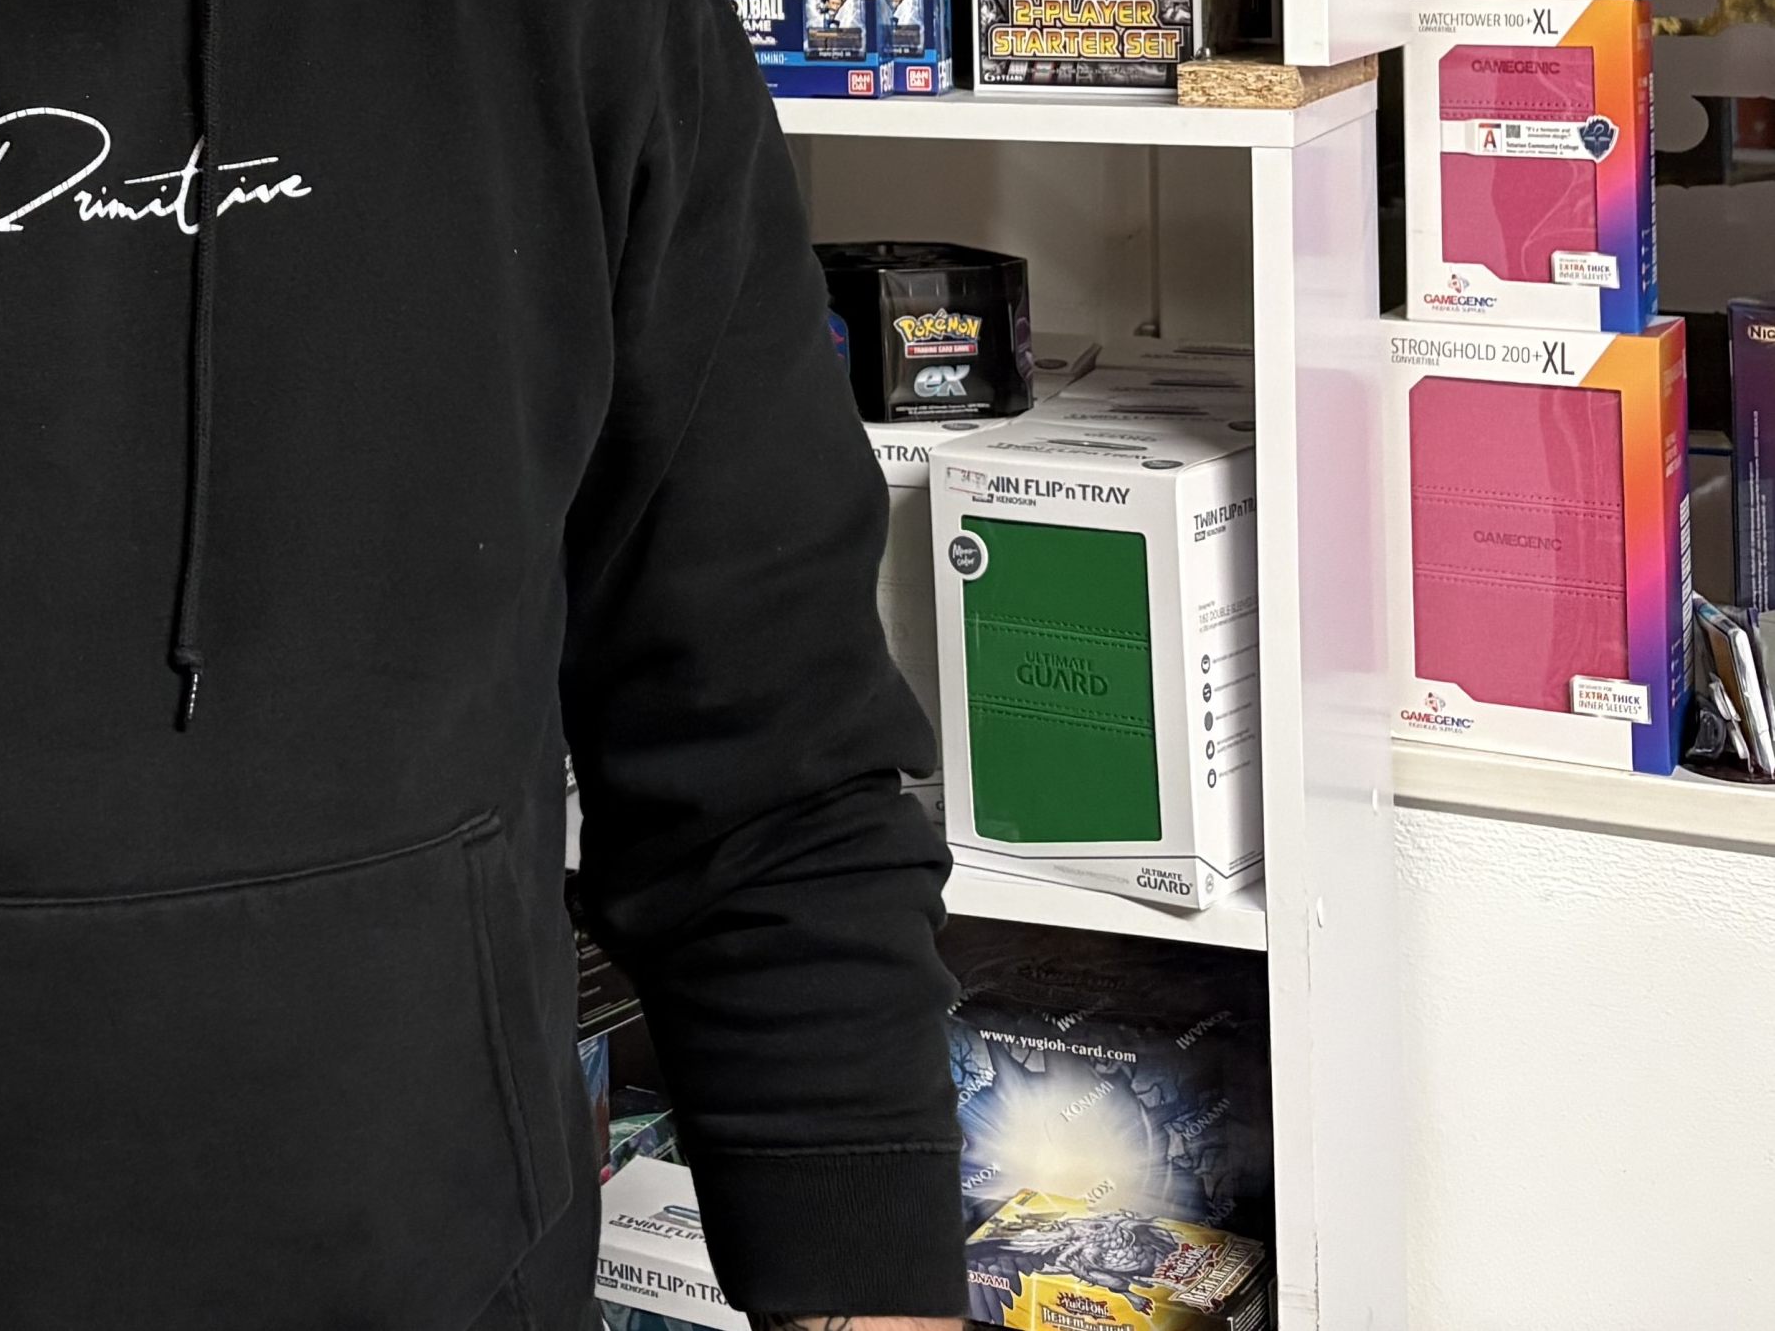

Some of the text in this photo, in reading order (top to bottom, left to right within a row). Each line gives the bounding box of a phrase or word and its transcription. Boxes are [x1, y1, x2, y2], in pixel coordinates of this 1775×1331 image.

[1419, 13, 1501, 28] WATCHTOWER
[1533, 8, 1559, 35] XL
[992, 28, 1180, 59] STARTER SET
[1471, 59, 1561, 75] GAMEGENIC
[1483, 130, 1497, 149] A
[1559, 264, 1585, 272] EXTRA
[1424, 294, 1494, 308] GAMEGENIC
[1390, 337, 1496, 361] STRONGHOLD
[1542, 340, 1575, 376] XL
[1391, 355, 1440, 367] CONVERTIBLE
[914, 365, 970, 398] ex
[881, 445, 931, 463] TRAY
[996, 495, 1037, 506] XENOSKIN
[1077, 483, 1130, 505] TRAY
[1193, 509, 1218, 531] TWIN
[1473, 529, 1562, 552] GAMEGENIC
[1025, 651, 1093, 672] ULTIMATE
[1015, 663, 1109, 697] GUARD
[1578, 690, 1641, 705] EXTRA THICK
[1578, 700, 1638, 713] INNER SLEEVES
[1401, 709, 1471, 729] GAMEGENIC
[1141, 867, 1183, 882] ULTIMATE
[1136, 875, 1191, 896] GUARD
[980, 1028, 1136, 1064] www.yugioh-card.com
[1061, 1080, 1115, 1122] KONAMI
[1182, 1098, 1230, 1141] KONAMI
[618, 1214, 663, 1231] TWIN
[597, 1258, 642, 1284] TWIN
